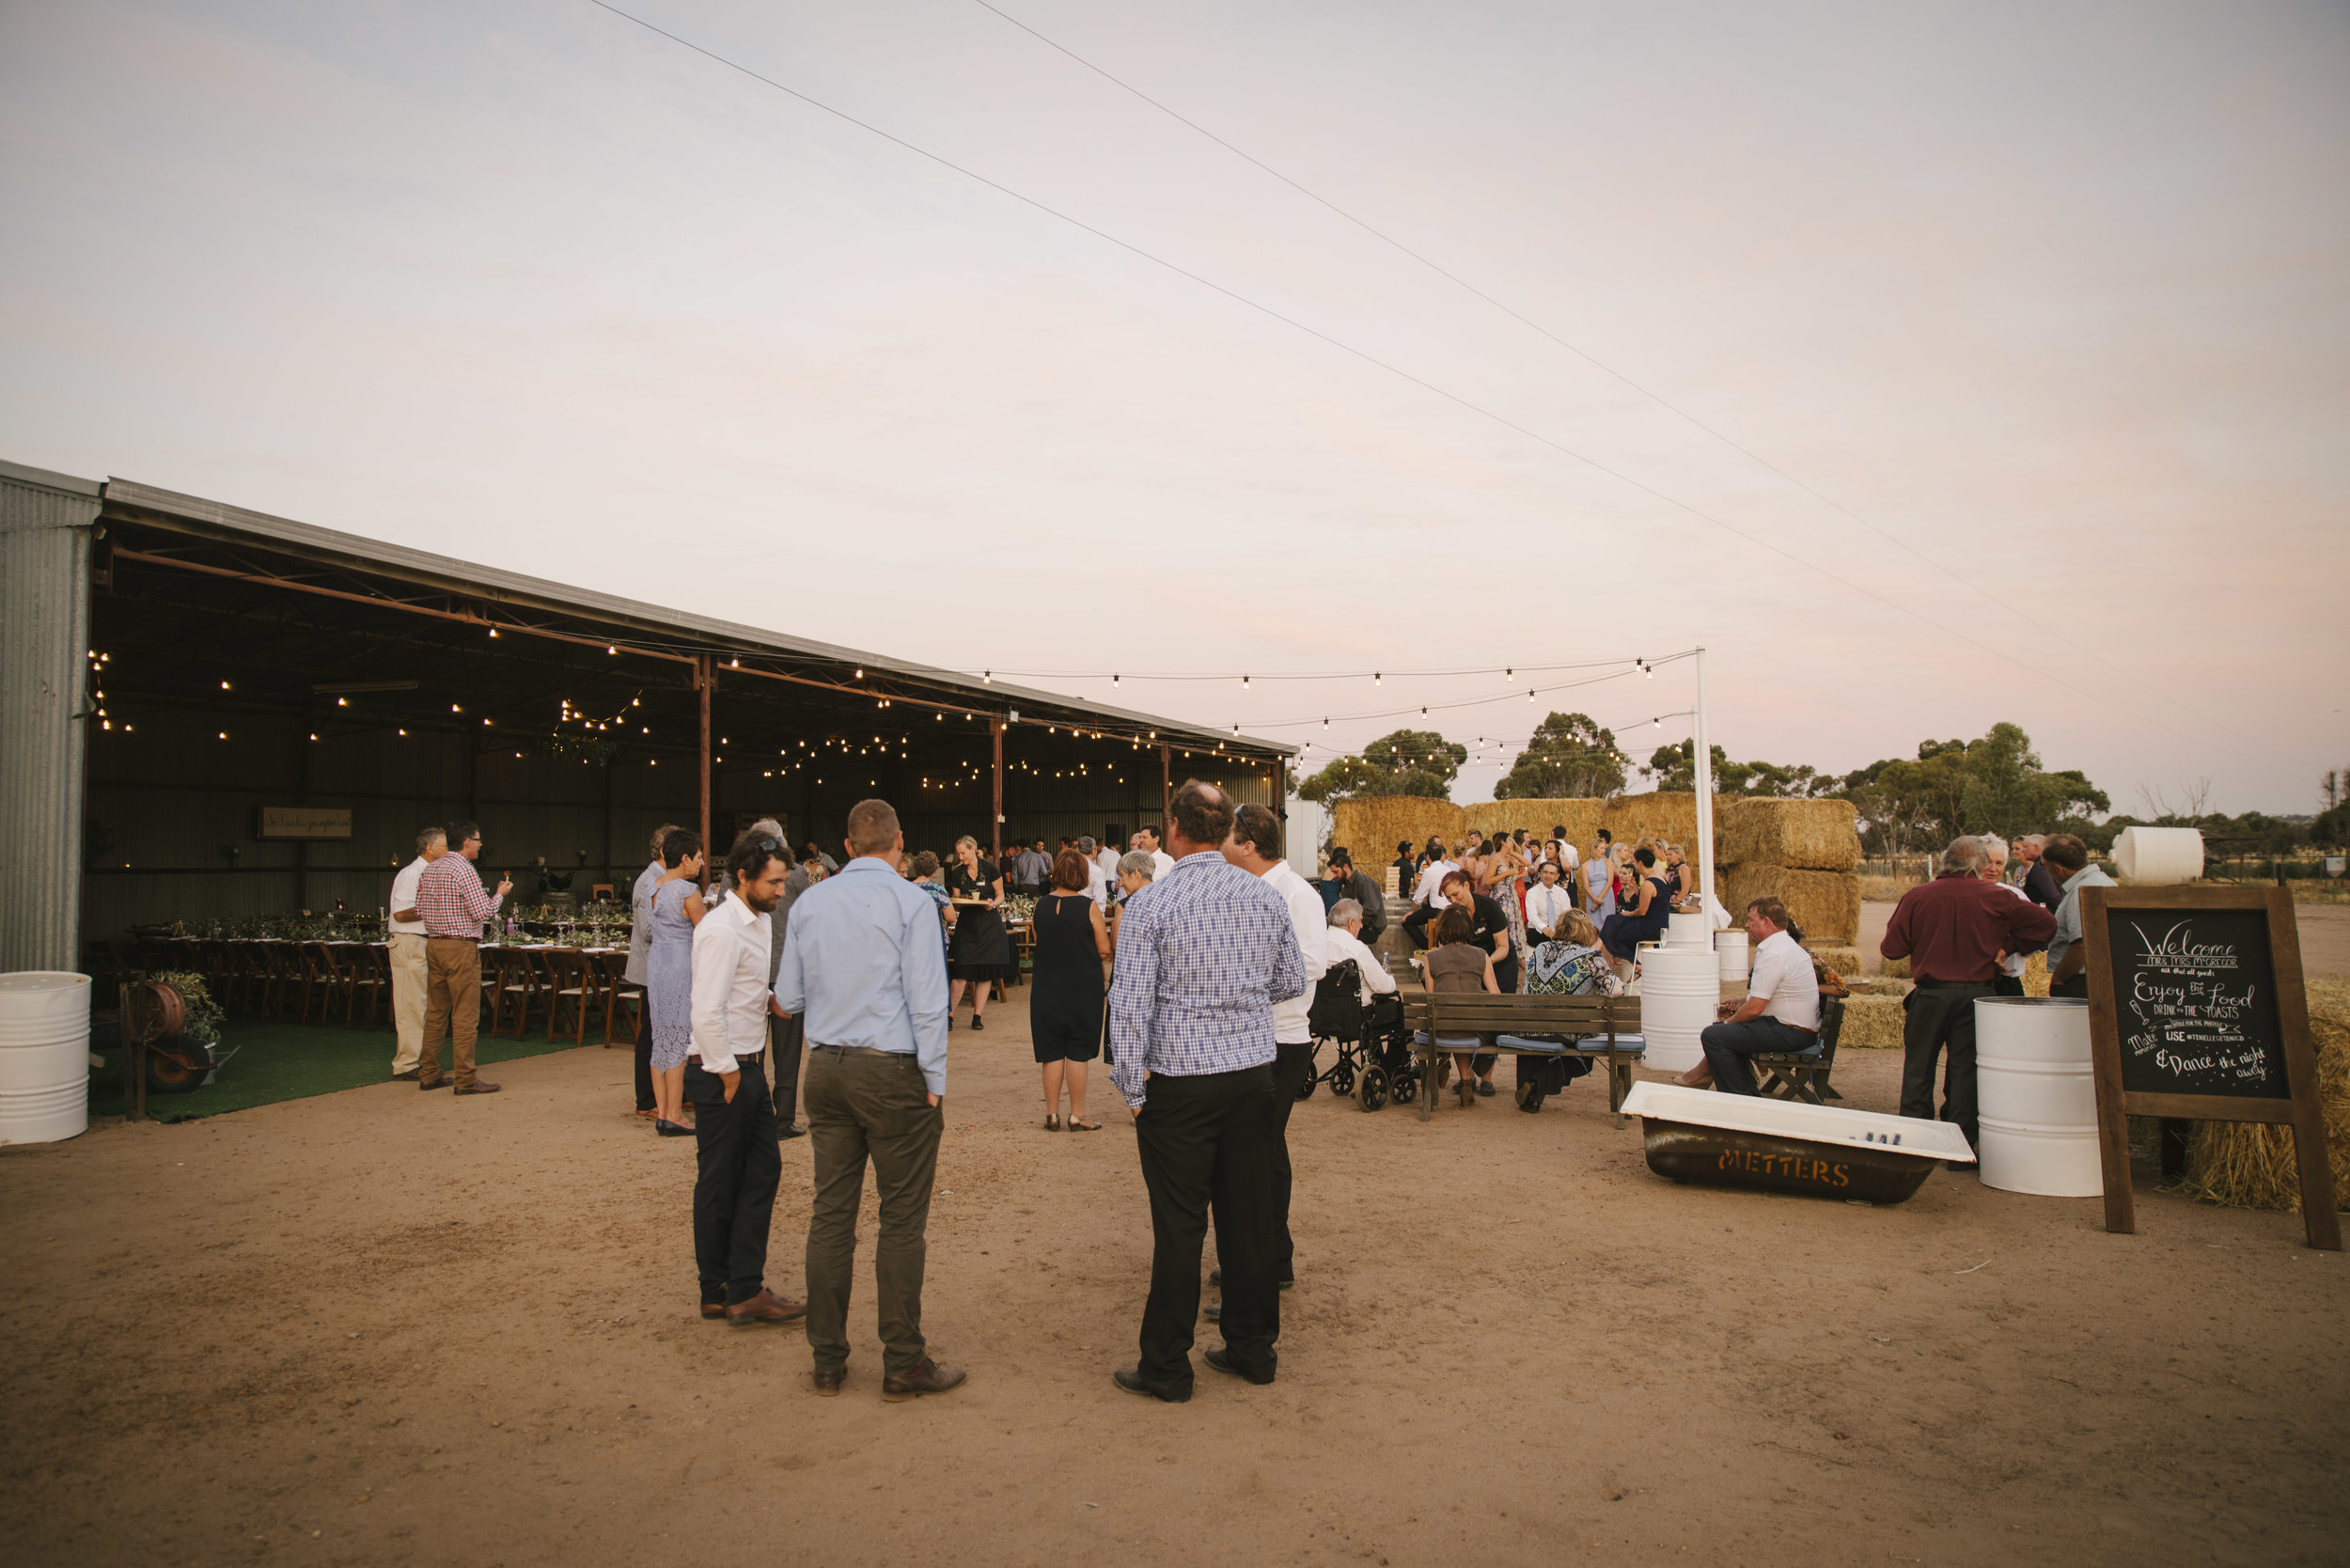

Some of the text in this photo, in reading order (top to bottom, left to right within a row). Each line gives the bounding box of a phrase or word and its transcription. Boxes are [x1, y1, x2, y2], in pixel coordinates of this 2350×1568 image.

[2130, 918, 2235, 957] Welcome
[2170, 956, 2190, 967] MRS
[2197, 968, 2215, 978] guests
[2134, 972, 2186, 1006] Enjoy
[2207, 982, 2255, 1009] Food
[2154, 1004, 2176, 1015] DRINK
[2184, 1005, 2198, 1017] THE
[2201, 1005, 2240, 1019] TOASTS
[2127, 1031, 2158, 1050] Make
[2165, 1031, 2186, 1042] USE
[2155, 1046, 2265, 1077] & Dance the night
[2236, 1066, 2267, 1082] away
[1718, 1149, 1849, 1187] METTERS
